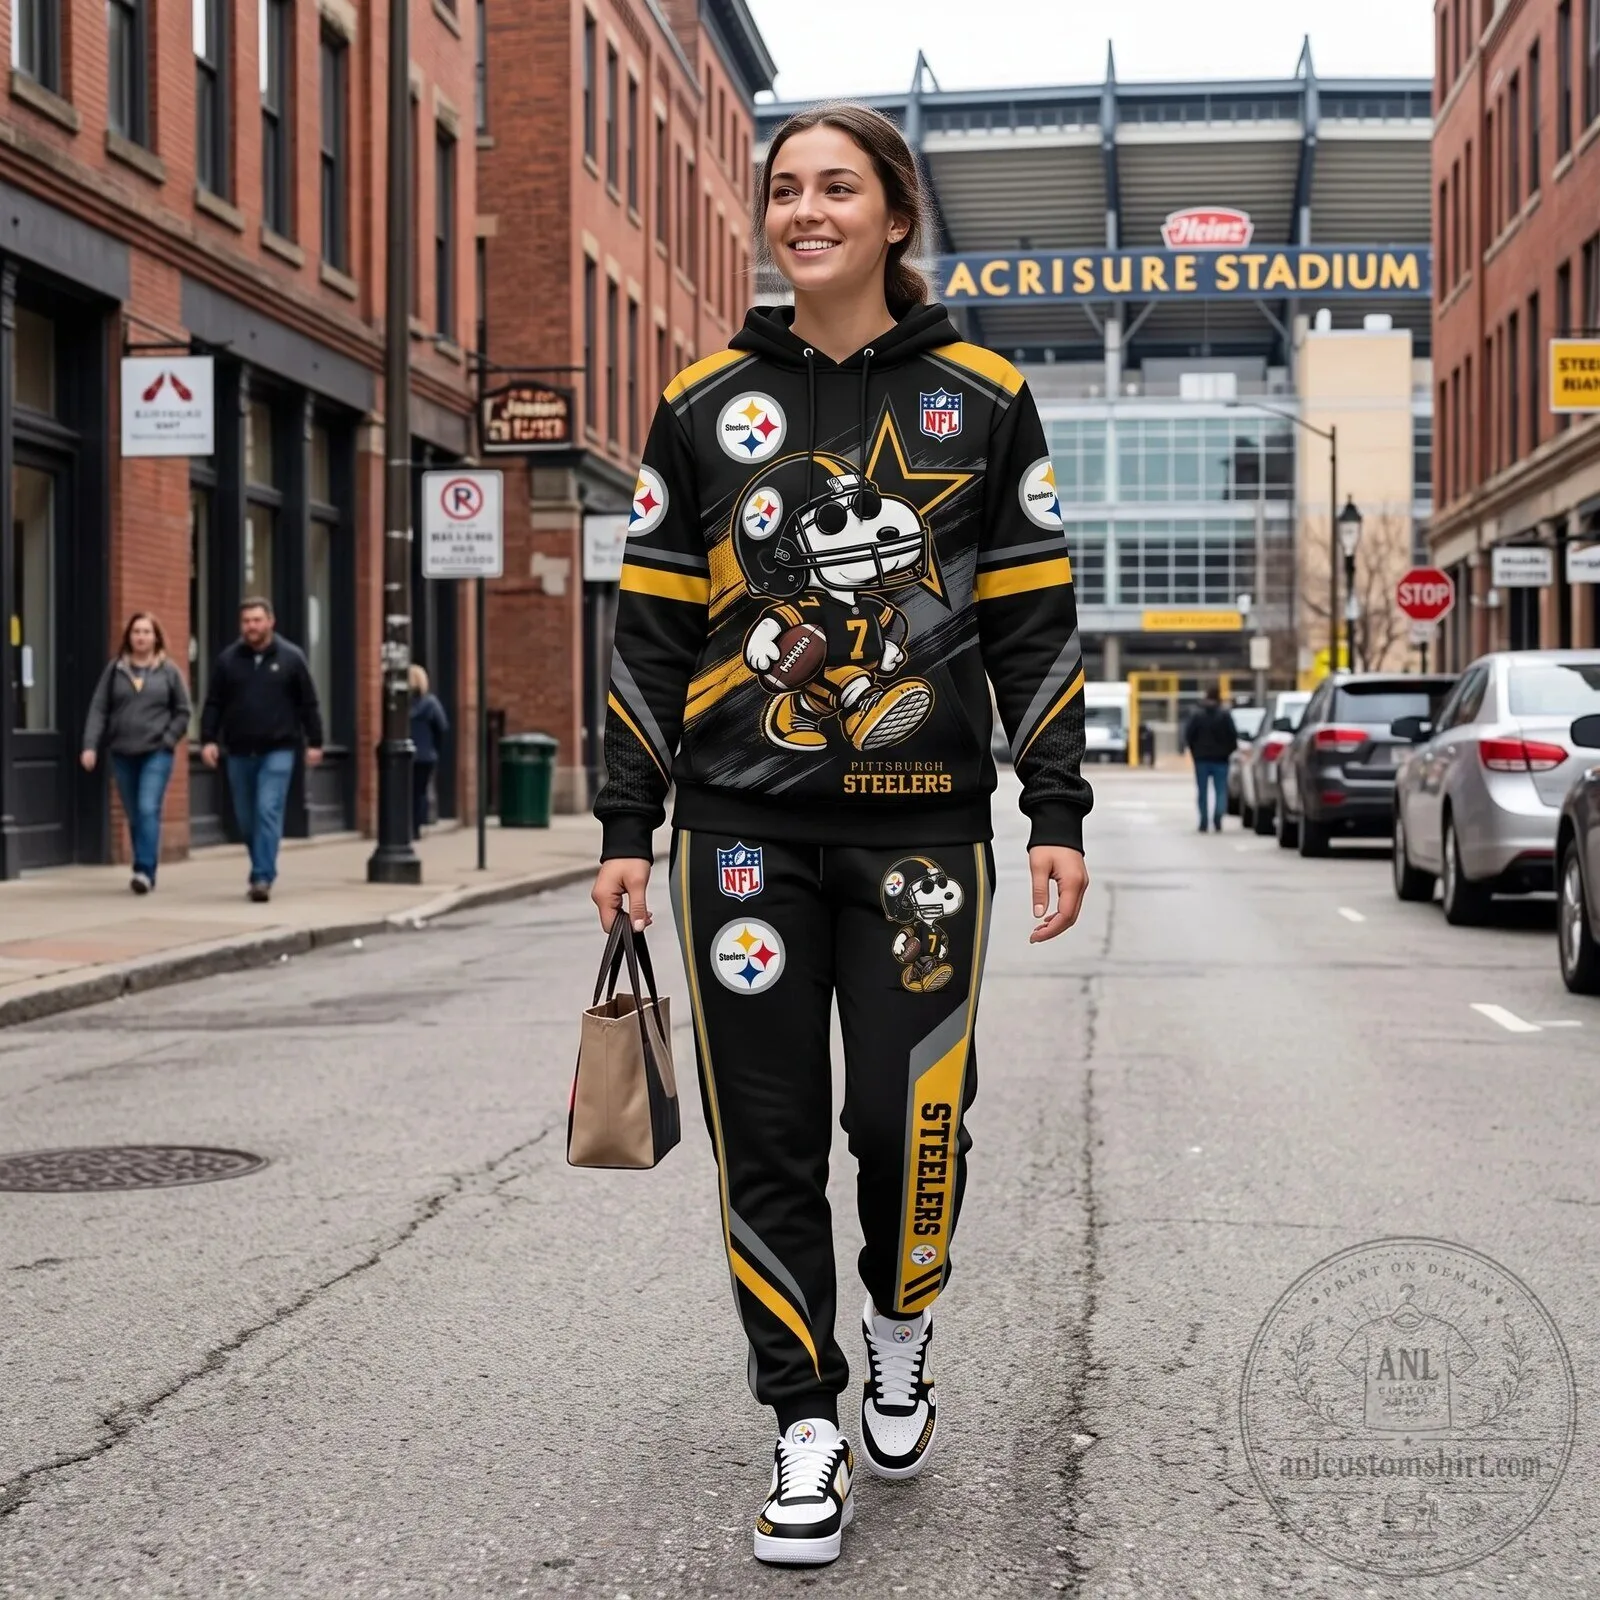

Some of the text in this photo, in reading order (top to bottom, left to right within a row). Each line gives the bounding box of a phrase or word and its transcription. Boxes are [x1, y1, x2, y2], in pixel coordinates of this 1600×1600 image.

[1168, 216, 1245, 244] Heinz
[945, 253, 1420, 297] ACRISURE STADIUM
[725, 423, 750, 432] Steelers
[925, 410, 958, 435] NFL
[1027, 491, 1054, 502] Steelers
[1399, 582, 1449, 606] STOP
[846, 619, 868, 660] 7
[851, 761, 943, 772] PITTSBURGH
[843, 774, 952, 794] STEELERS
[723, 867, 760, 894] NFL
[928, 934, 937, 953] 7
[719, 952, 746, 962] Steelers
[913, 1103, 952, 1236] STEELERS
